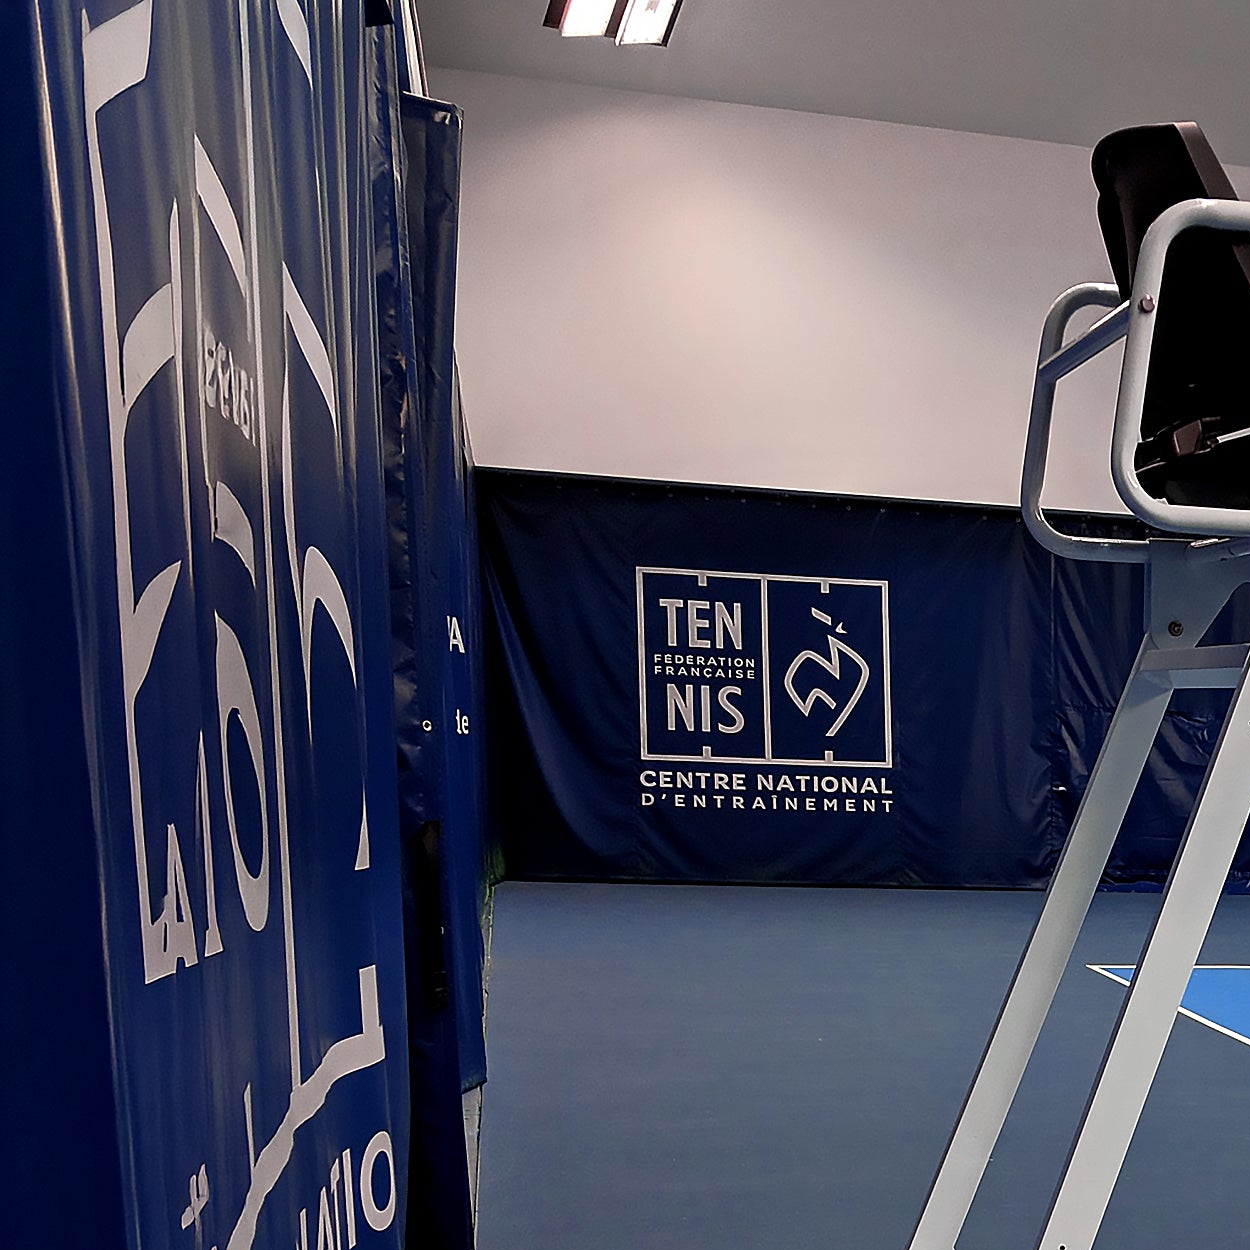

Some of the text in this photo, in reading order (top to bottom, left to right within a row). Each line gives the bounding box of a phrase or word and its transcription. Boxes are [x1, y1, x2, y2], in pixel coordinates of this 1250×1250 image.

[659, 598, 742, 650] TEN
[654, 653, 755, 668] FÉDÉRATION
[654, 665, 755, 680] FRANÇAISE
[666, 683, 745, 734] NIS
[640, 770, 893, 795] CENTRE NATIONAL
[641, 792, 894, 813] D'ENTRAÎNEMENT
